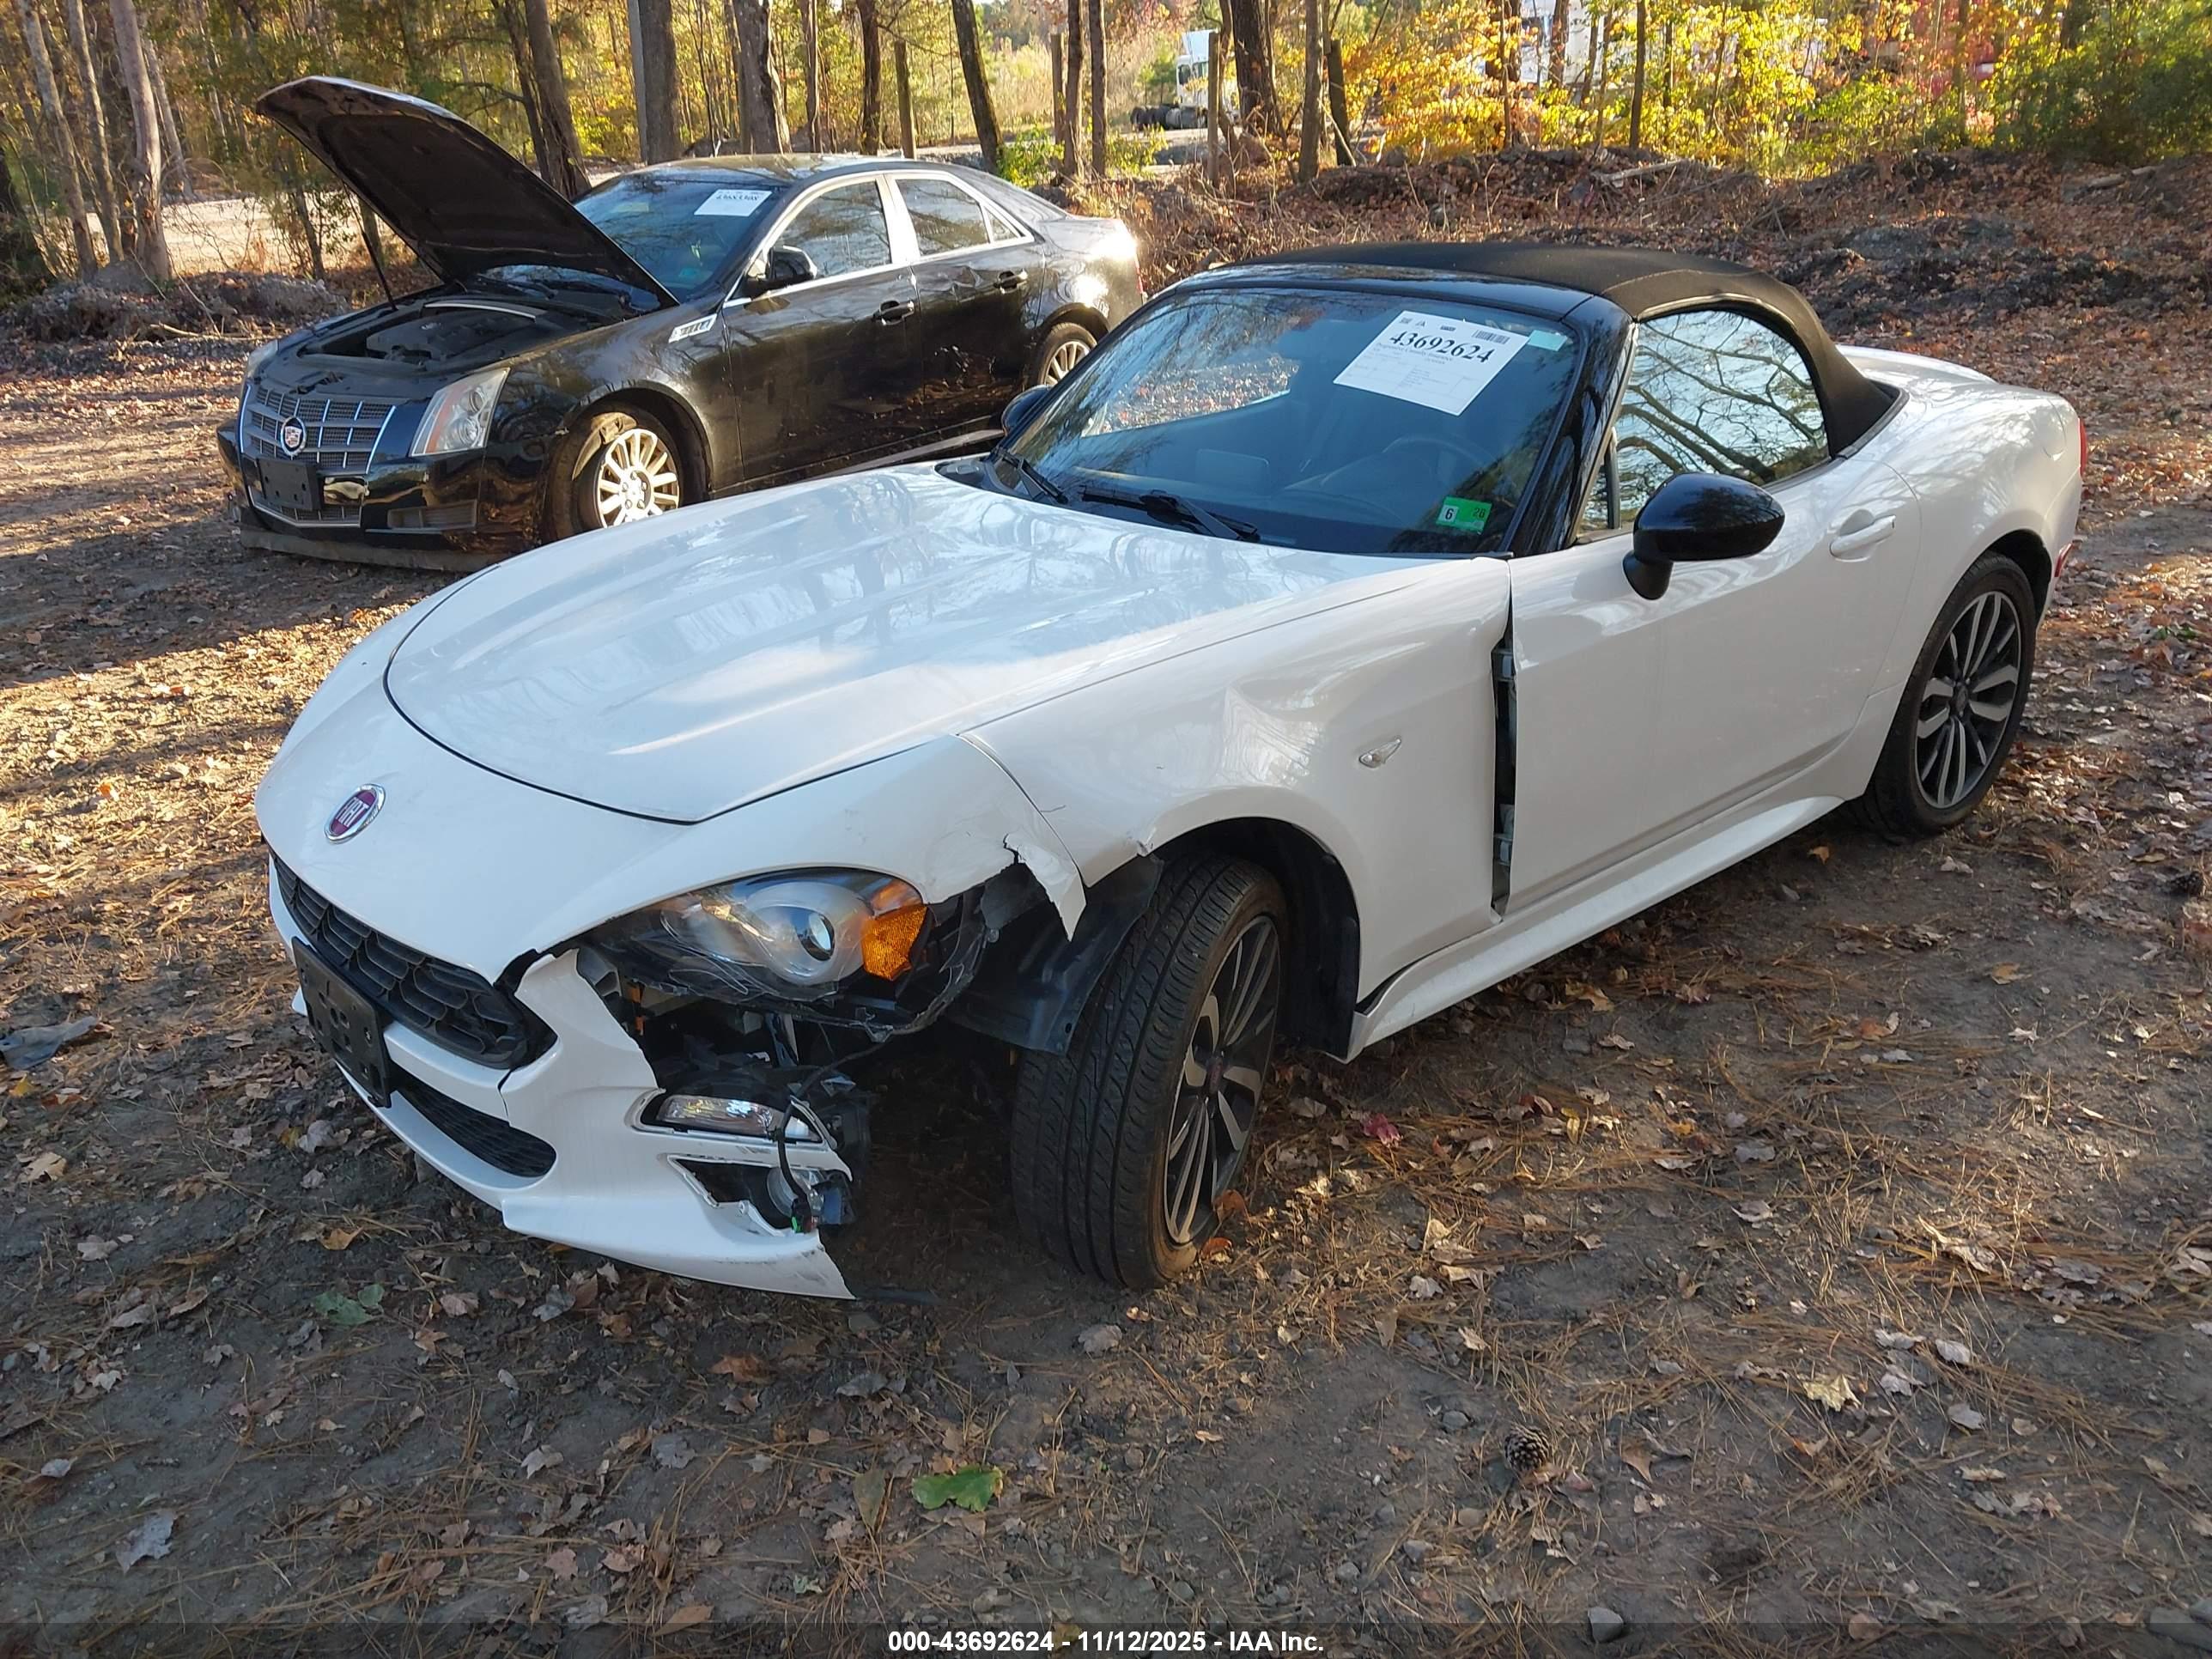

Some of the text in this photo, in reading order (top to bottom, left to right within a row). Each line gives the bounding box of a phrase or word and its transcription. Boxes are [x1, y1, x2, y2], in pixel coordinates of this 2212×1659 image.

[1389, 331, 1495, 362] 43692624
[1445, 508, 1455, 520] 6
[335, 796, 370, 828] FIAT
